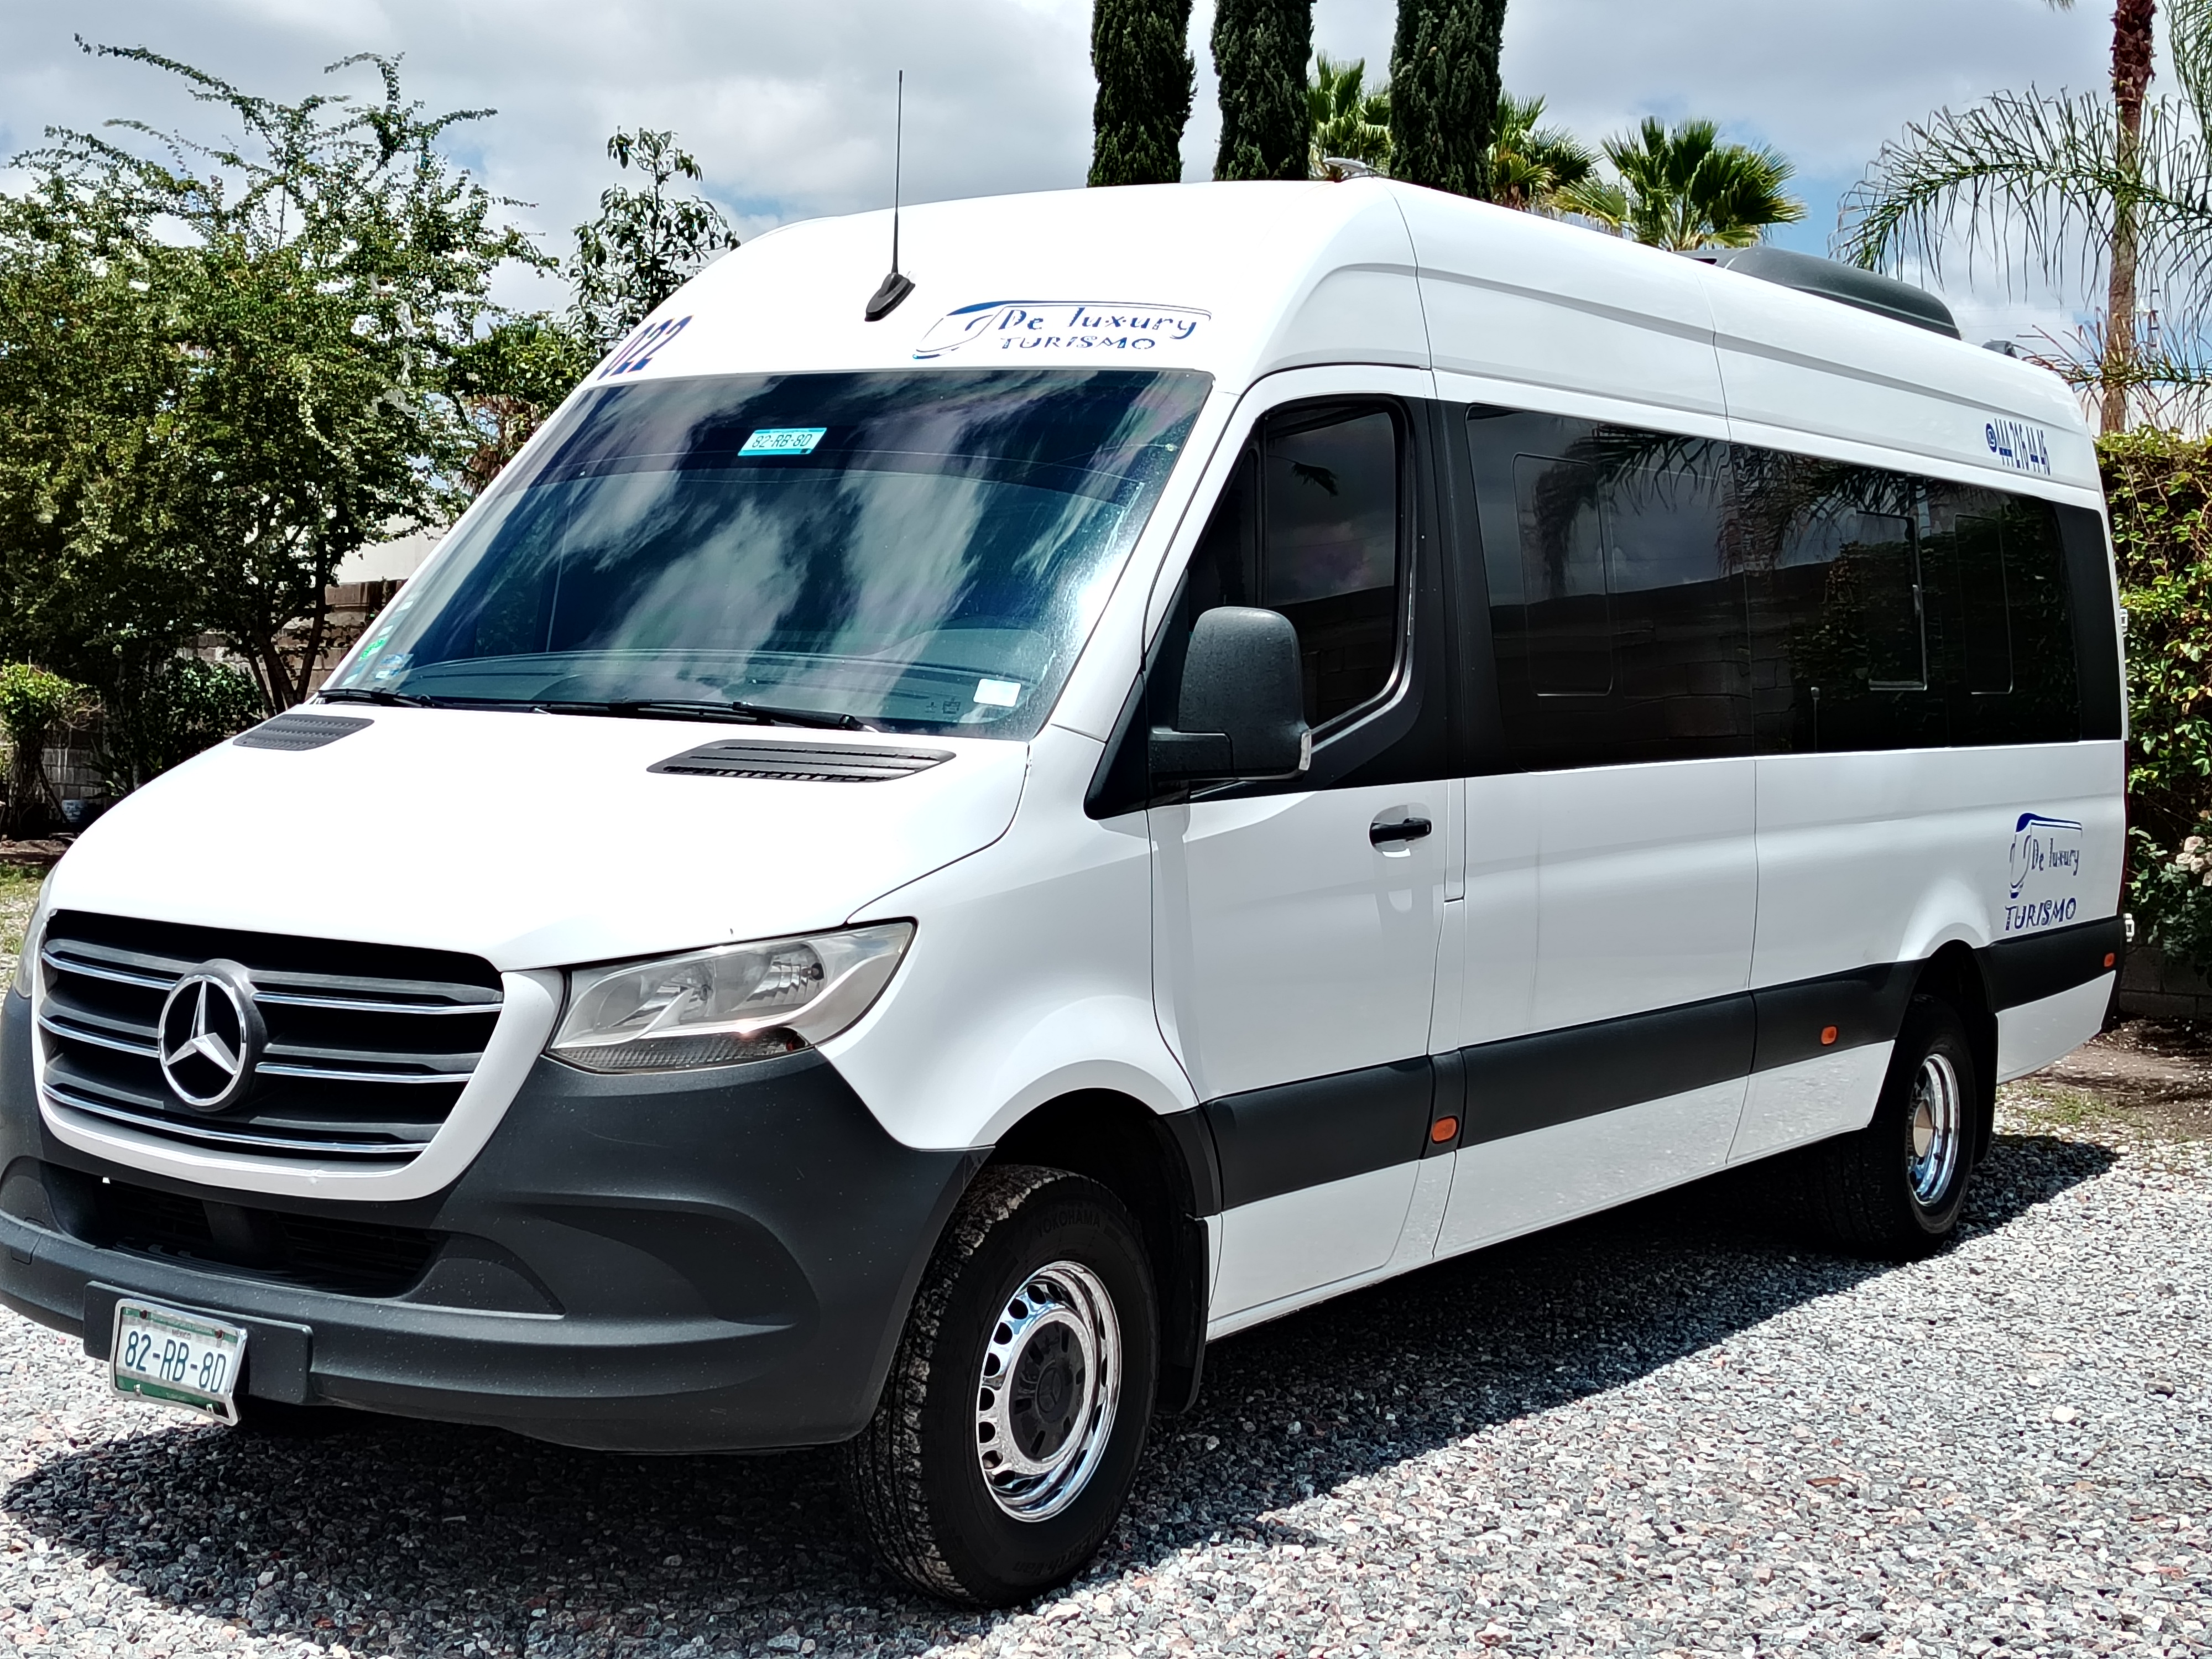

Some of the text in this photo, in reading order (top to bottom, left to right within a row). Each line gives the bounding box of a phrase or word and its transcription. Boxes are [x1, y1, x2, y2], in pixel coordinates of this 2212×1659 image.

[998, 309, 1044, 330] De
[597, 315, 694, 380] 022
[1000, 336, 1156, 349] TURISMO
[1994, 418, 2013, 467] 444
[2009, 421, 2029, 471] 216
[2026, 426, 2040, 473] 44
[2031, 839, 2044, 871] De
[2005, 897, 2077, 931] TURISMO
[1035, 1208, 1101, 1238] YOKOHAMA
[124, 1331, 227, 1393] 82-RB-8D
